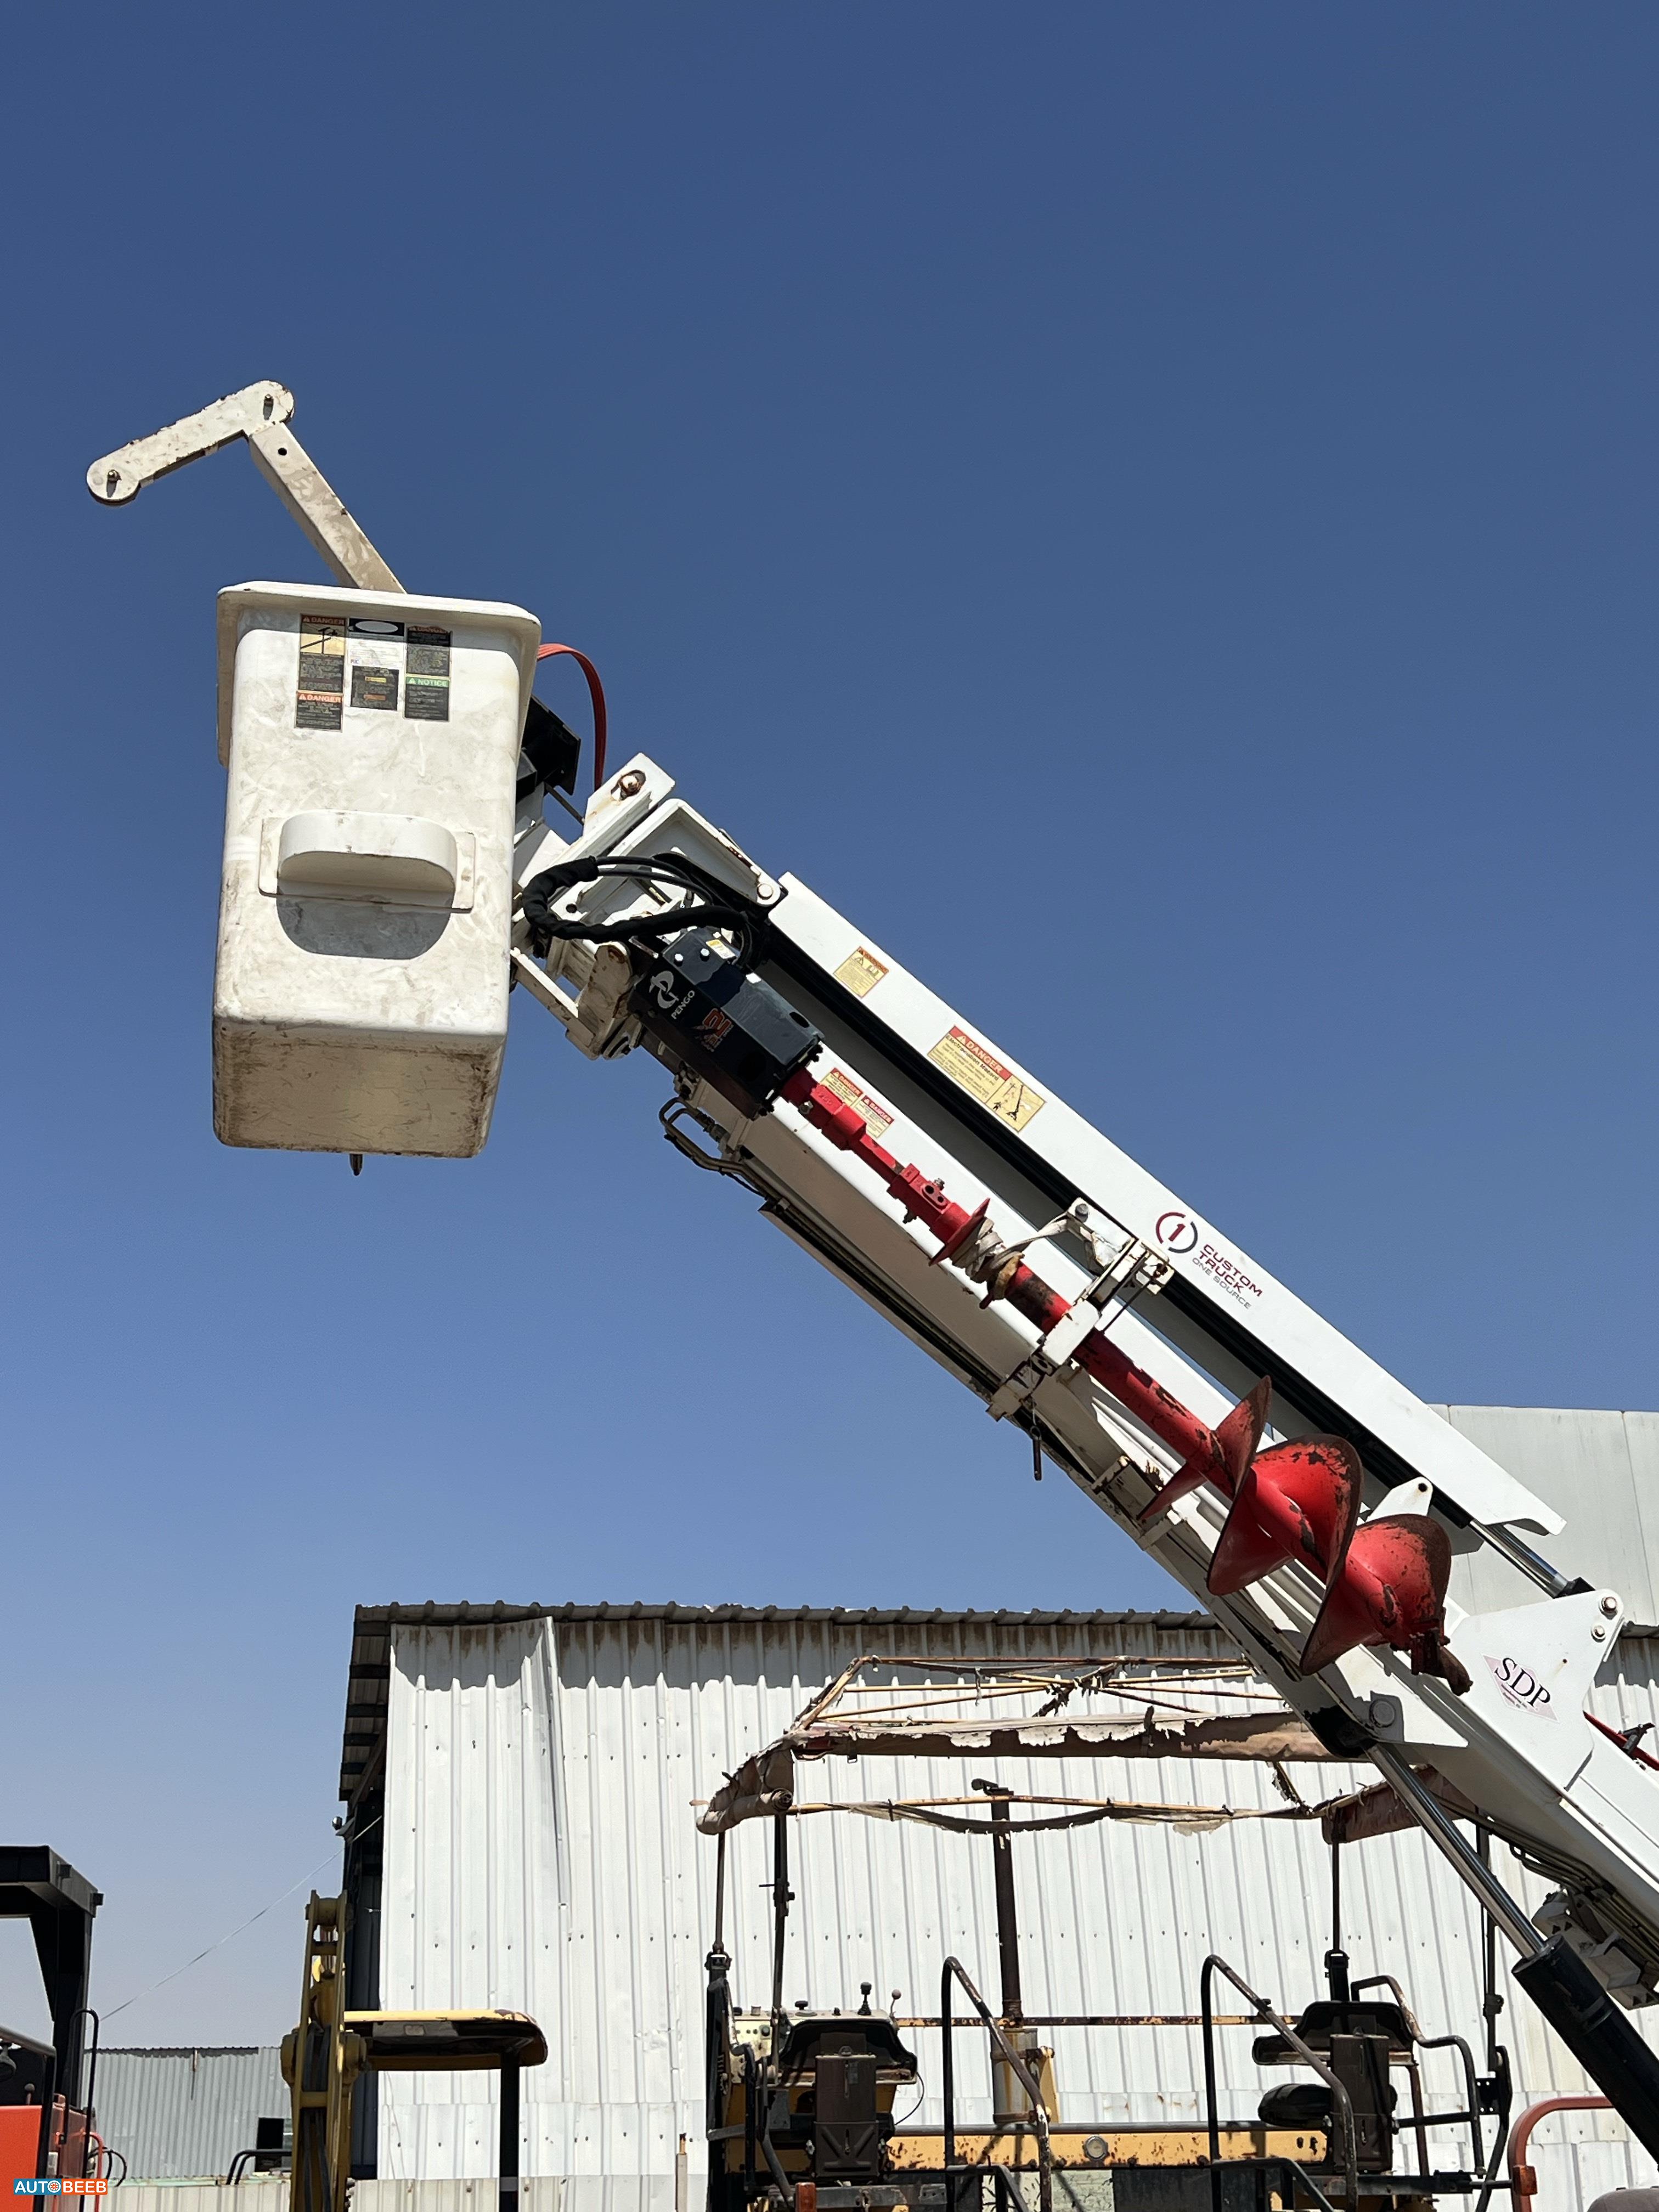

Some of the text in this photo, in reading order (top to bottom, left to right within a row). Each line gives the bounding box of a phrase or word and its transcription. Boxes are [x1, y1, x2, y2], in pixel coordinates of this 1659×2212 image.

[311, 617, 345, 625] DANGER
[307, 695, 342, 703] DANGER
[417, 679, 448, 687] NOTICE
[671, 990, 695, 1019] PENGO
[966, 1042, 1004, 1074] DANGER
[1192, 1257, 1252, 1309] ONE SOURCE
[1199, 1250, 1245, 1293] TRUCK
[1203, 1244, 1263, 1297] CUSTOM
[1494, 1657, 1550, 1707] SDP
